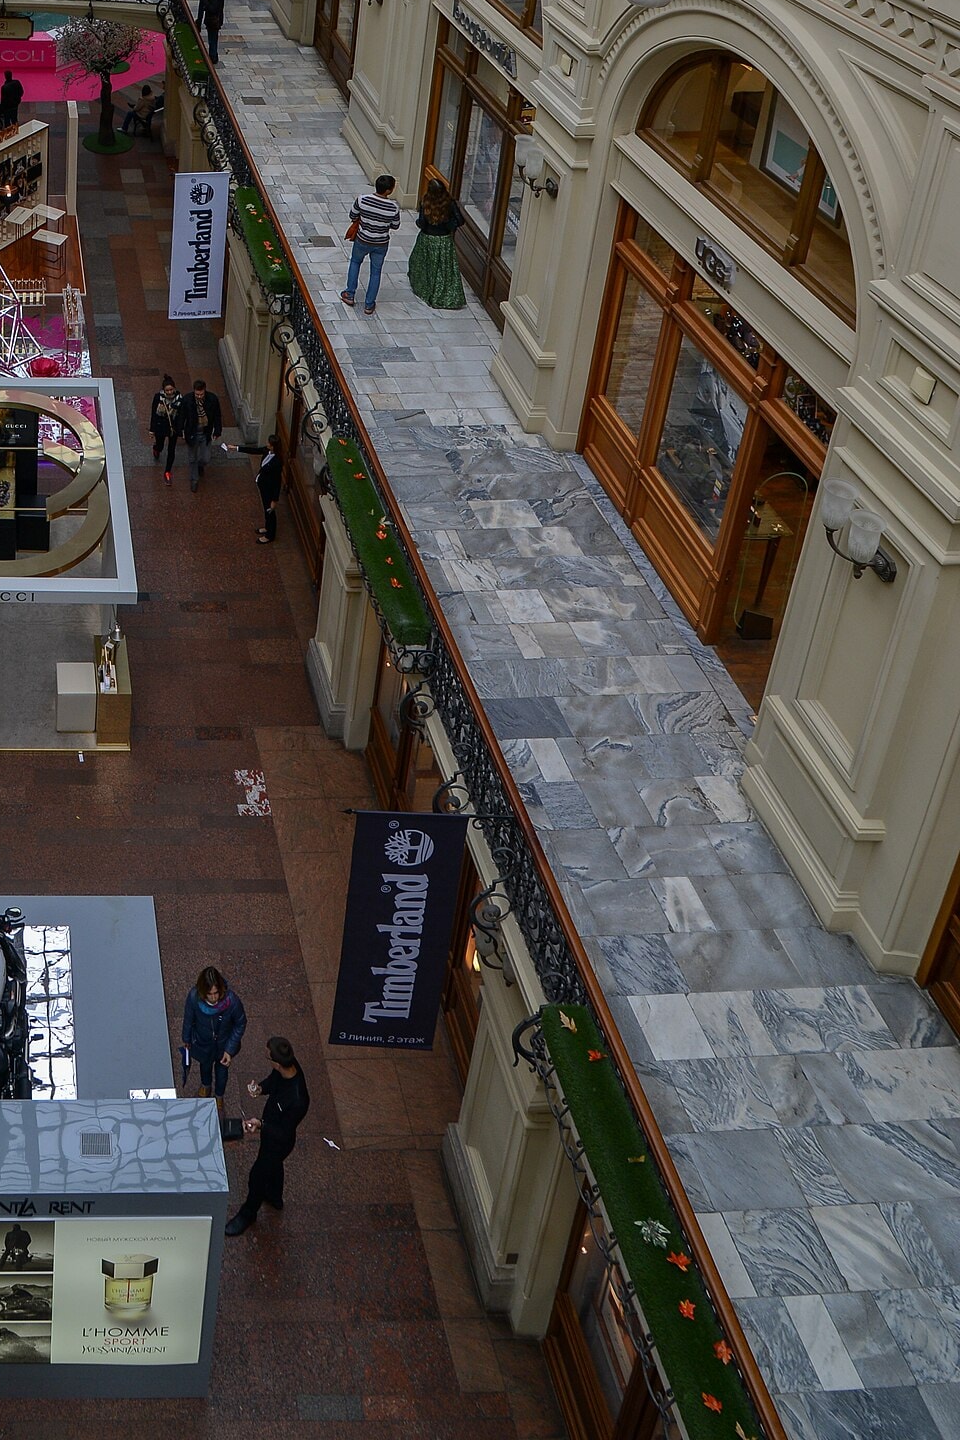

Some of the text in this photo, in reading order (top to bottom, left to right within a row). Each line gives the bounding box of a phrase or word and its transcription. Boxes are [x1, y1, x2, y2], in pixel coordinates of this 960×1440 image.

[184, 208, 213, 304] Timberland
[362, 873, 429, 1023] Timberland
[339, 1031, 347, 1040] 3
[387, 1035, 394, 1043] 2
[396, 1036, 425, 1044] этаж
[82, 1326, 169, 1337] L'HOMME
